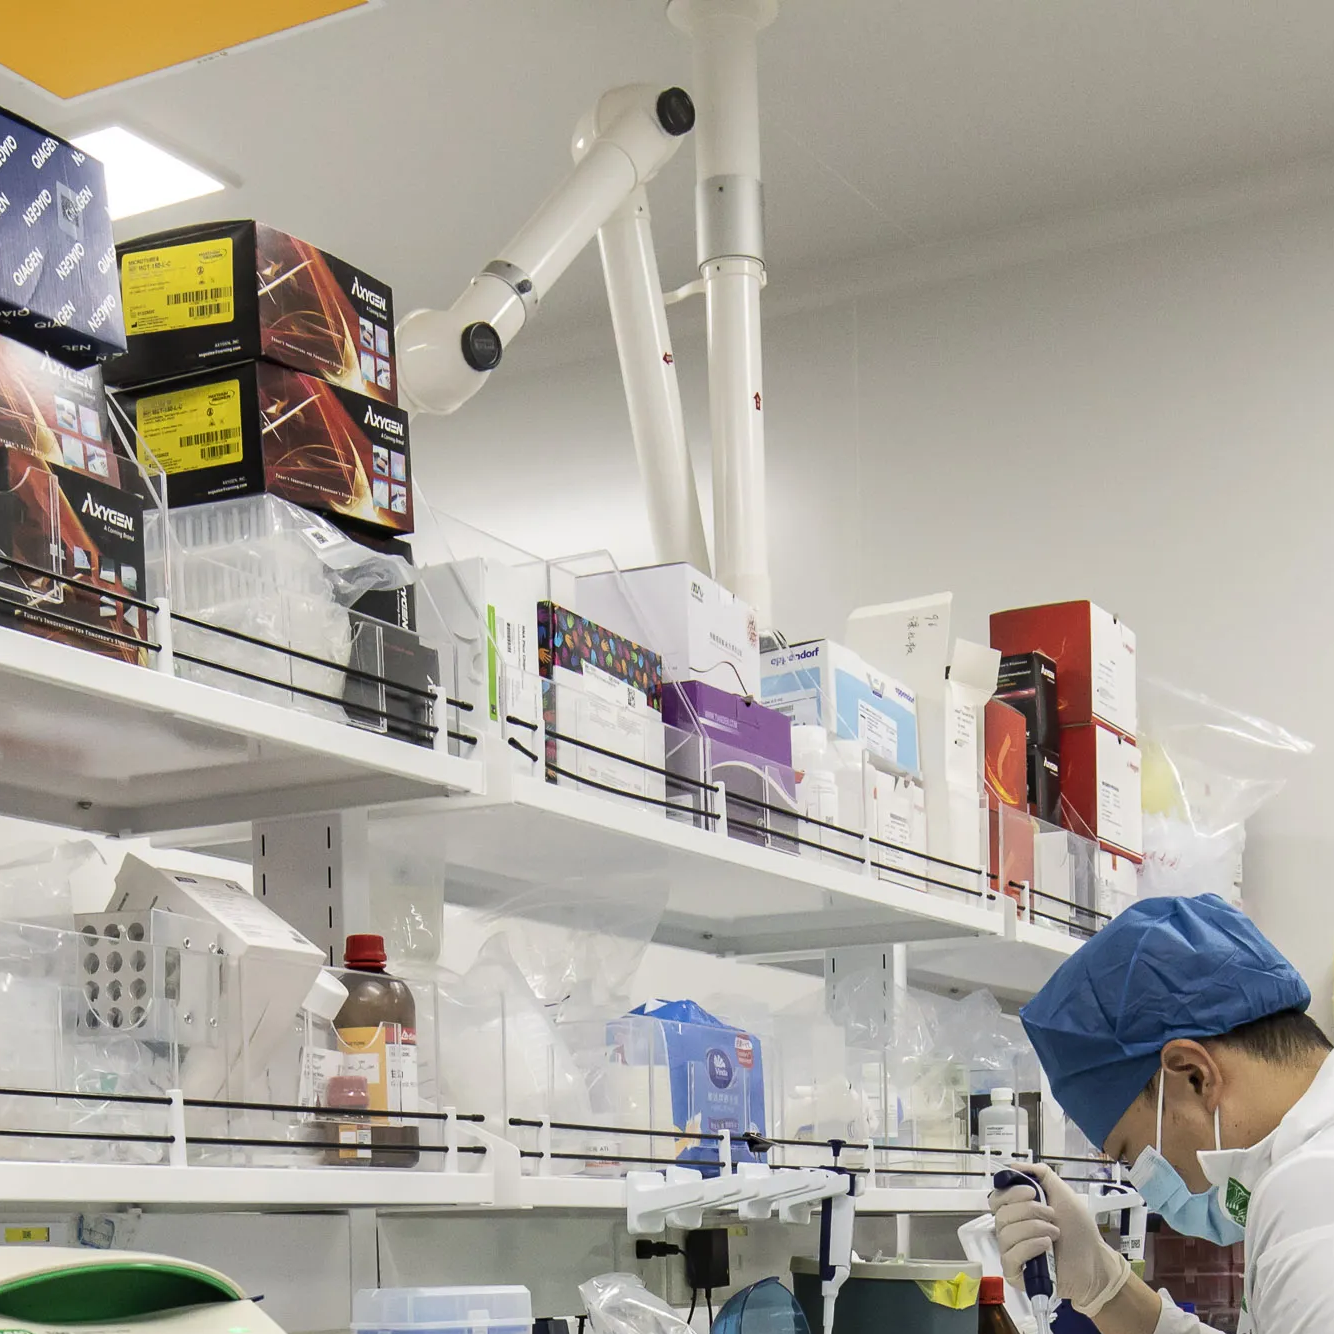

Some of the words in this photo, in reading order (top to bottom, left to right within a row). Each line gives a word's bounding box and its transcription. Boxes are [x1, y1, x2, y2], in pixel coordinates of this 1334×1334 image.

[22, 188, 52, 228] QIAGEN
[12, 247, 44, 287] QIAGEN
[55, 242, 85, 281] QIAGEN
[351, 276, 386, 311] AXYGEN
[87, 294, 117, 333] QIAGEN
[40, 350, 94, 390] AXYGEN
[364, 405, 405, 437] AXYGEN
[81, 492, 134, 531] AXYGEN
[401, 586, 409, 630] YGEN
[715, 1067, 728, 1077] Vinda
